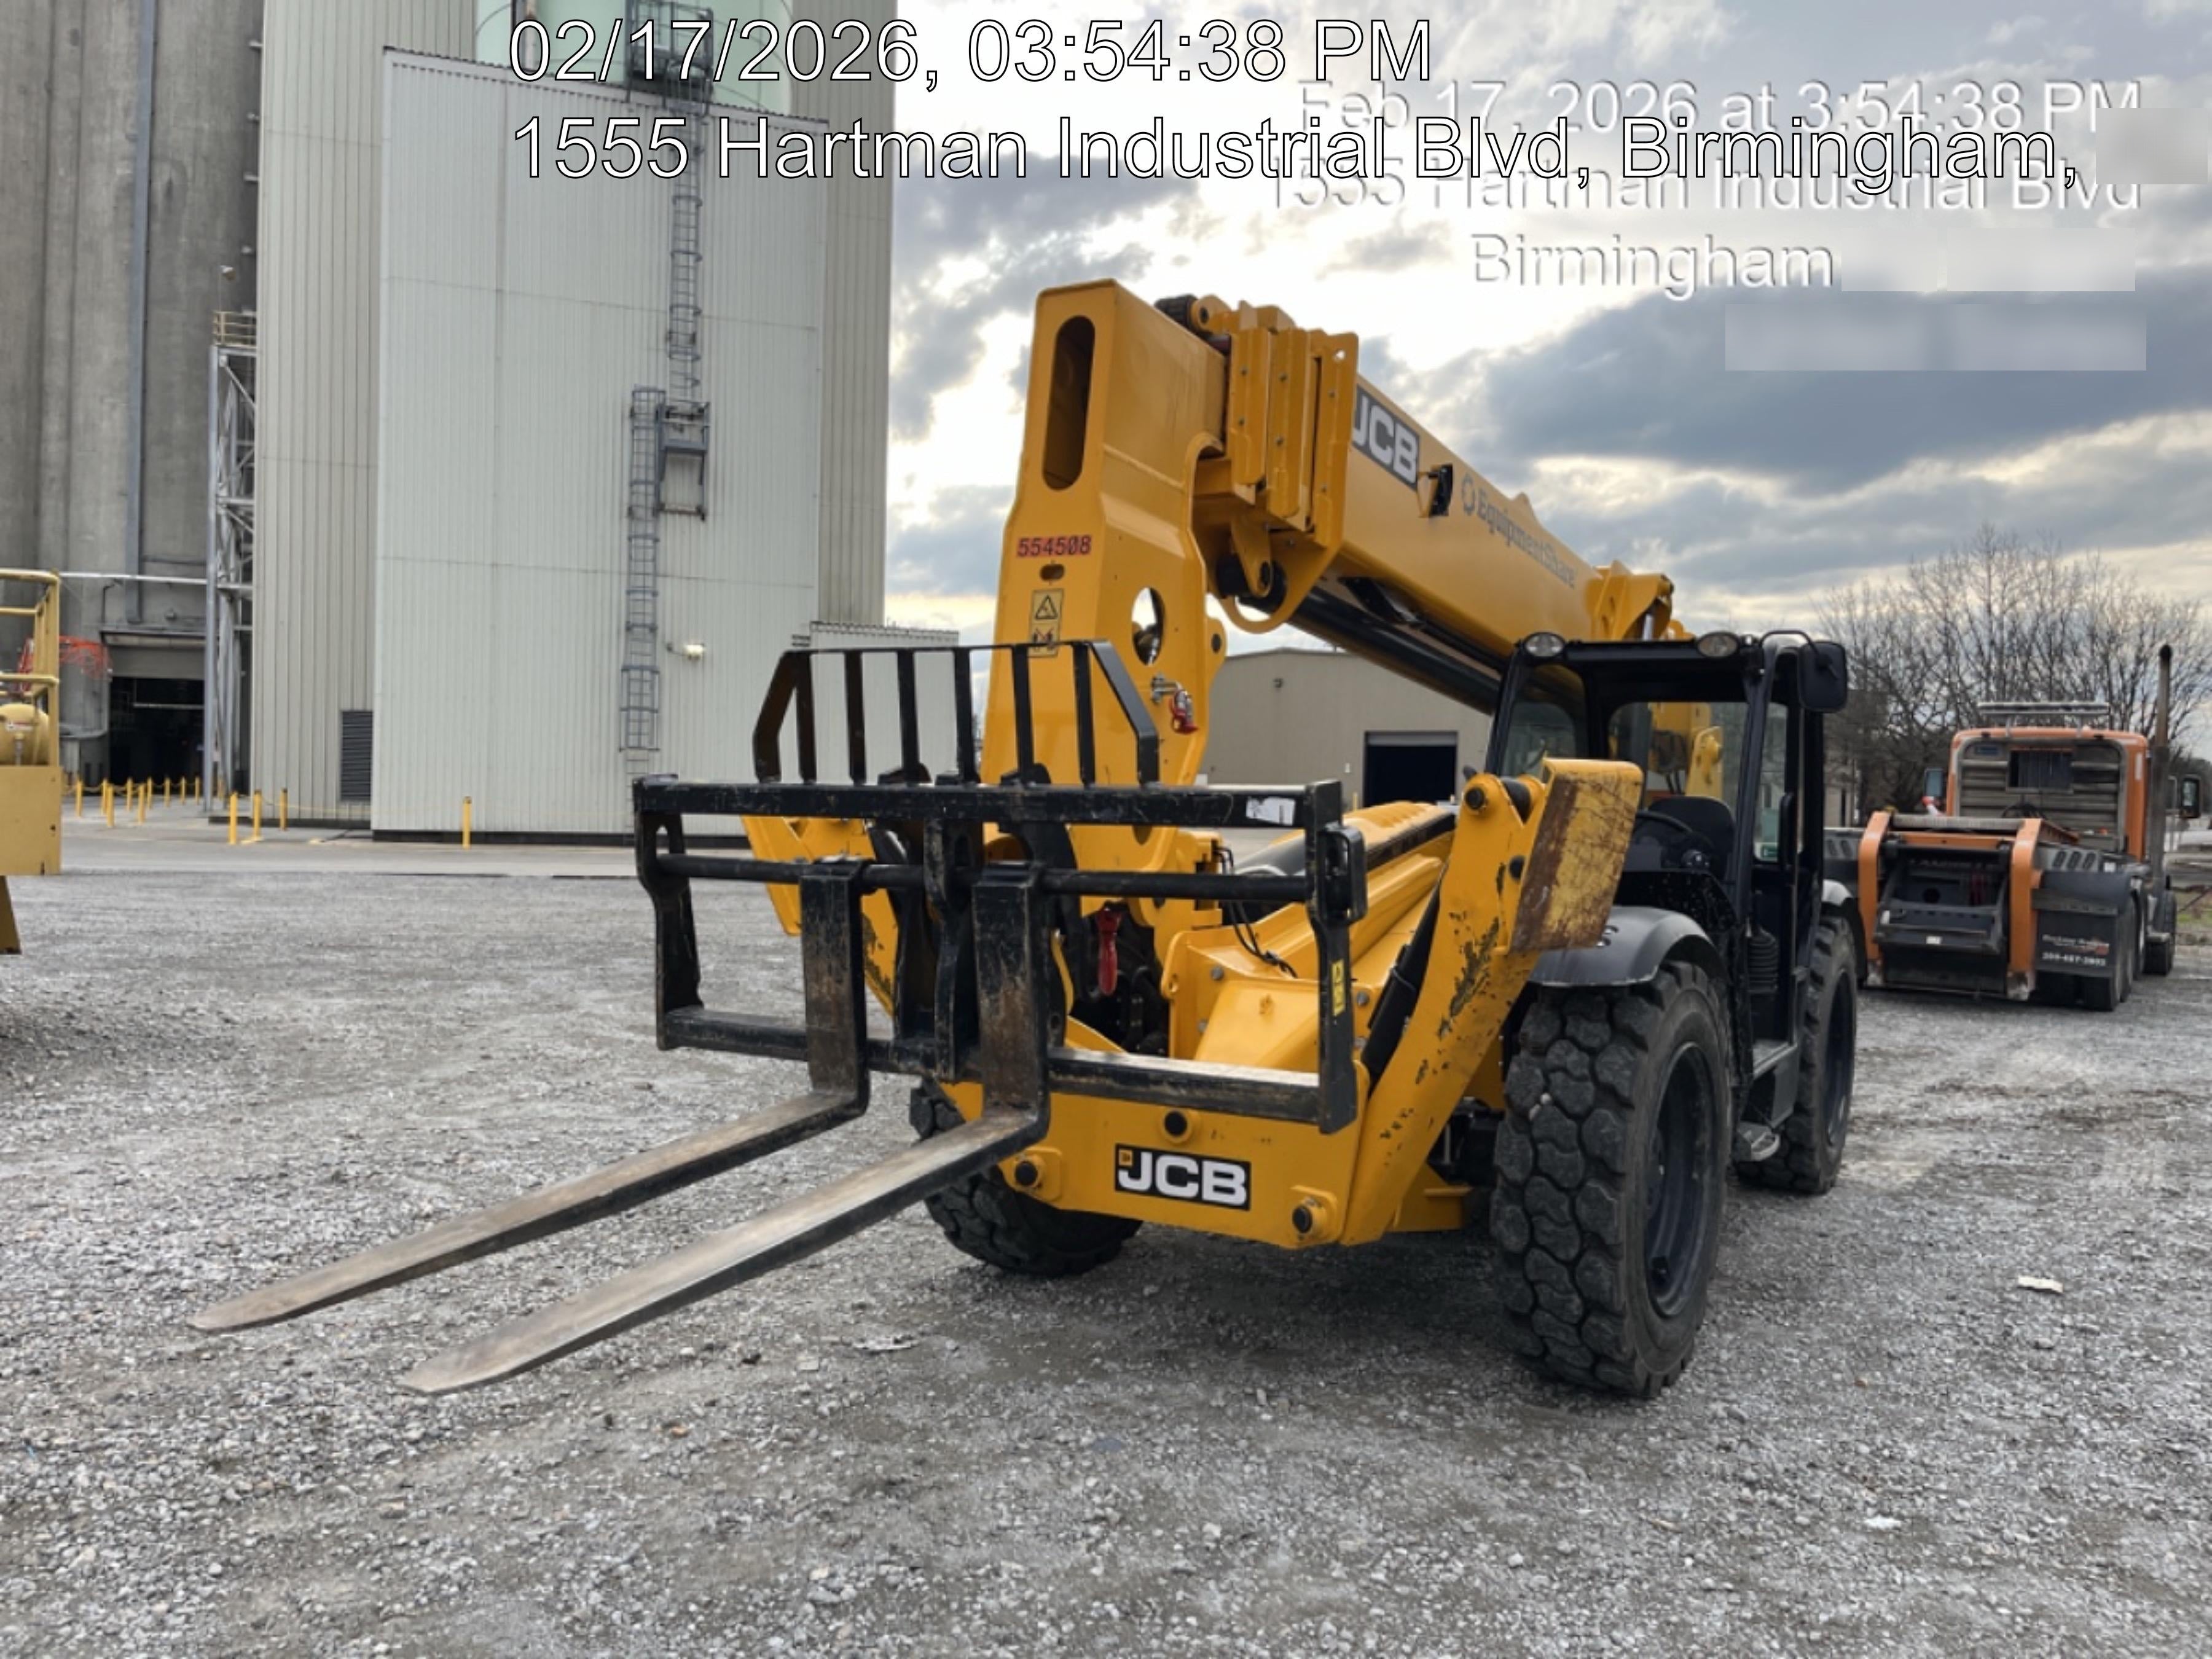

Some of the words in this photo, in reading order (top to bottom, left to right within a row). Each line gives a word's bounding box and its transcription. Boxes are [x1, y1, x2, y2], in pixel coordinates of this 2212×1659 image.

[1352, 393, 1419, 485] JCB
[1017, 534, 1092, 557] 554508
[1118, 1151, 1248, 1206] JCB
